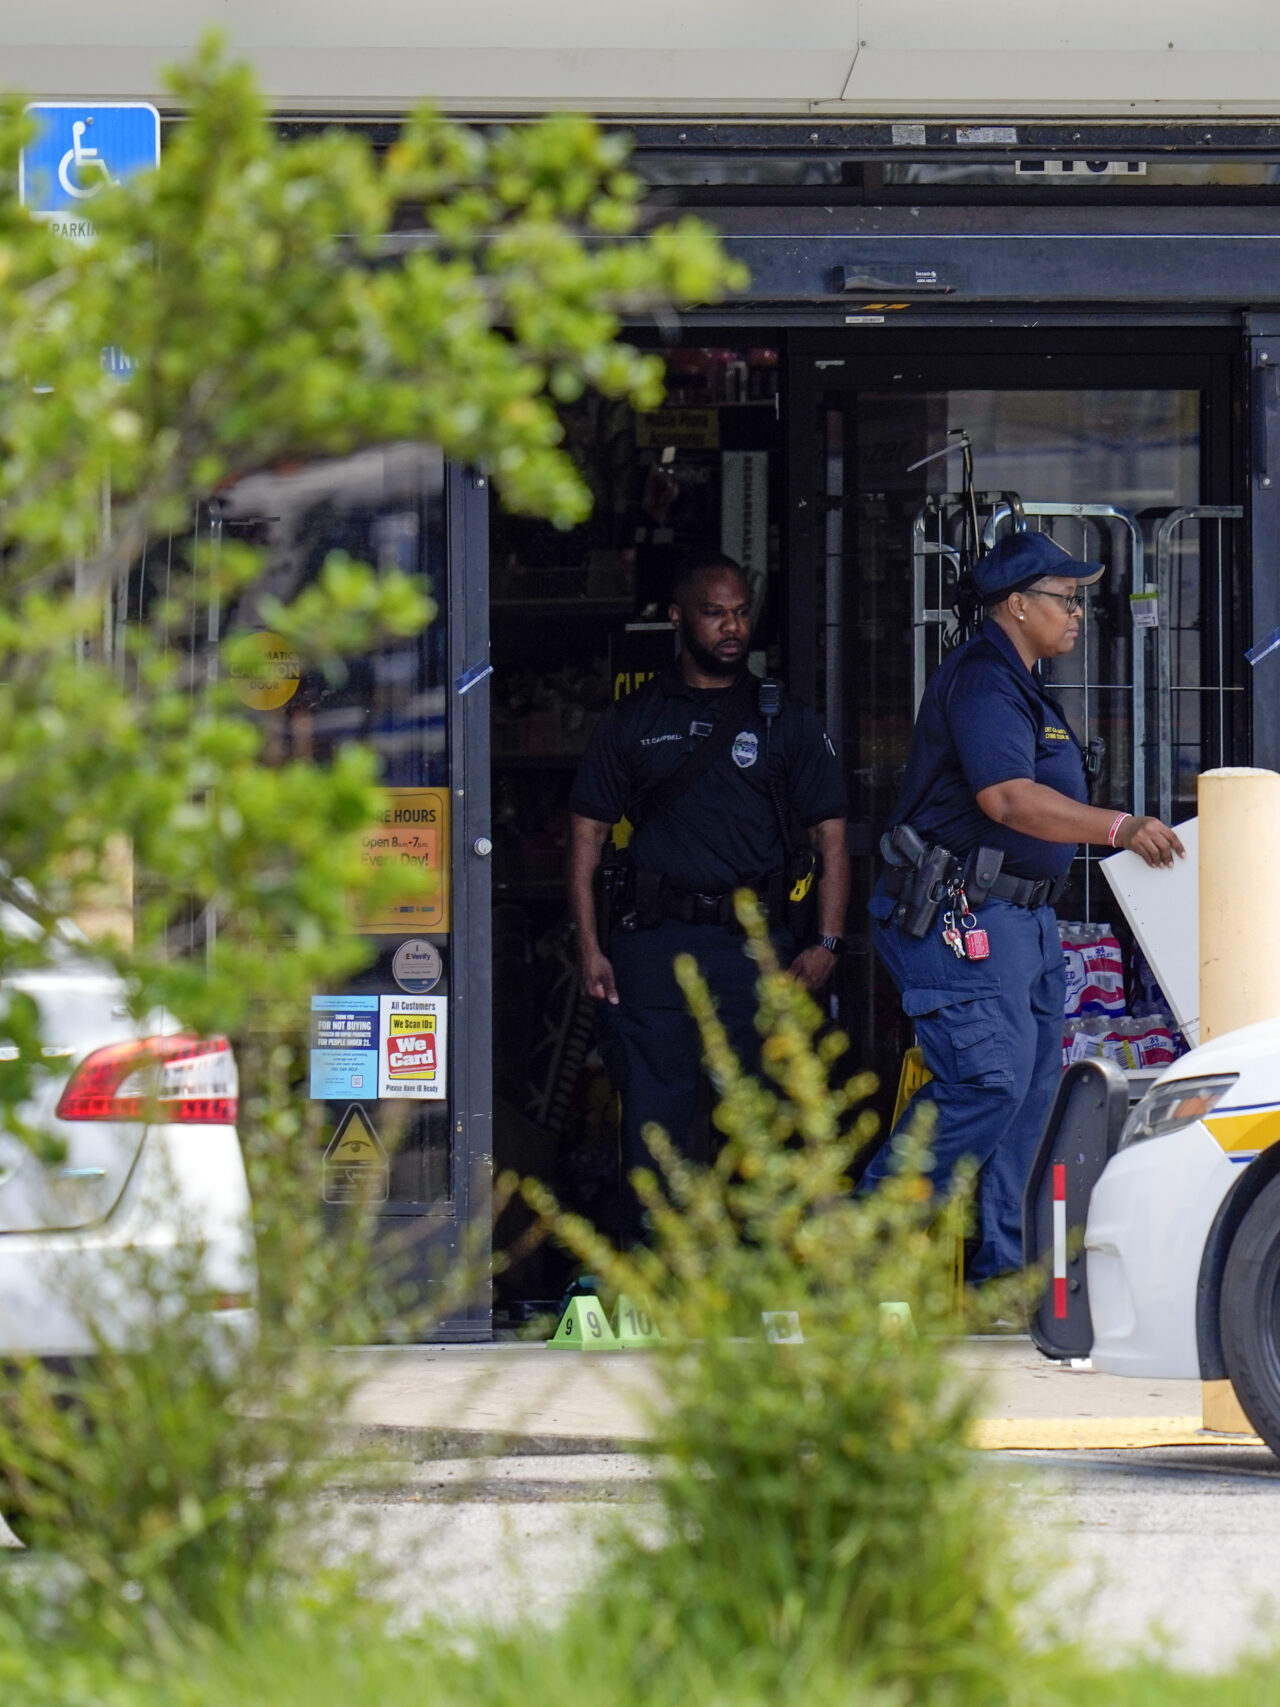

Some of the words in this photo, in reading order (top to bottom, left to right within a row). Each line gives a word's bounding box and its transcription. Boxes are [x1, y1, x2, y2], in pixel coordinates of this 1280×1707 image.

[52, 223, 99, 237] PARKIN
[394, 809, 436, 823] HOURS
[362, 837, 389, 849] Open
[391, 1001, 400, 1010] All
[401, 1001, 436, 1011] Customers
[318, 1021, 331, 1031] FOR
[332, 1021, 346, 1031] NOT
[346, 1021, 372, 1031] BUYING
[393, 1019, 404, 1028] We
[405, 1019, 421, 1029] Scan
[422, 1020, 433, 1029] IDs
[318, 1038, 328, 1046] FOR
[328, 1038, 346, 1046] PEOPLE
[396, 1036, 427, 1053] We
[389, 1049, 434, 1068] Card
[565, 1318, 573, 1336] 9
[587, 1311, 602, 1338] 9
